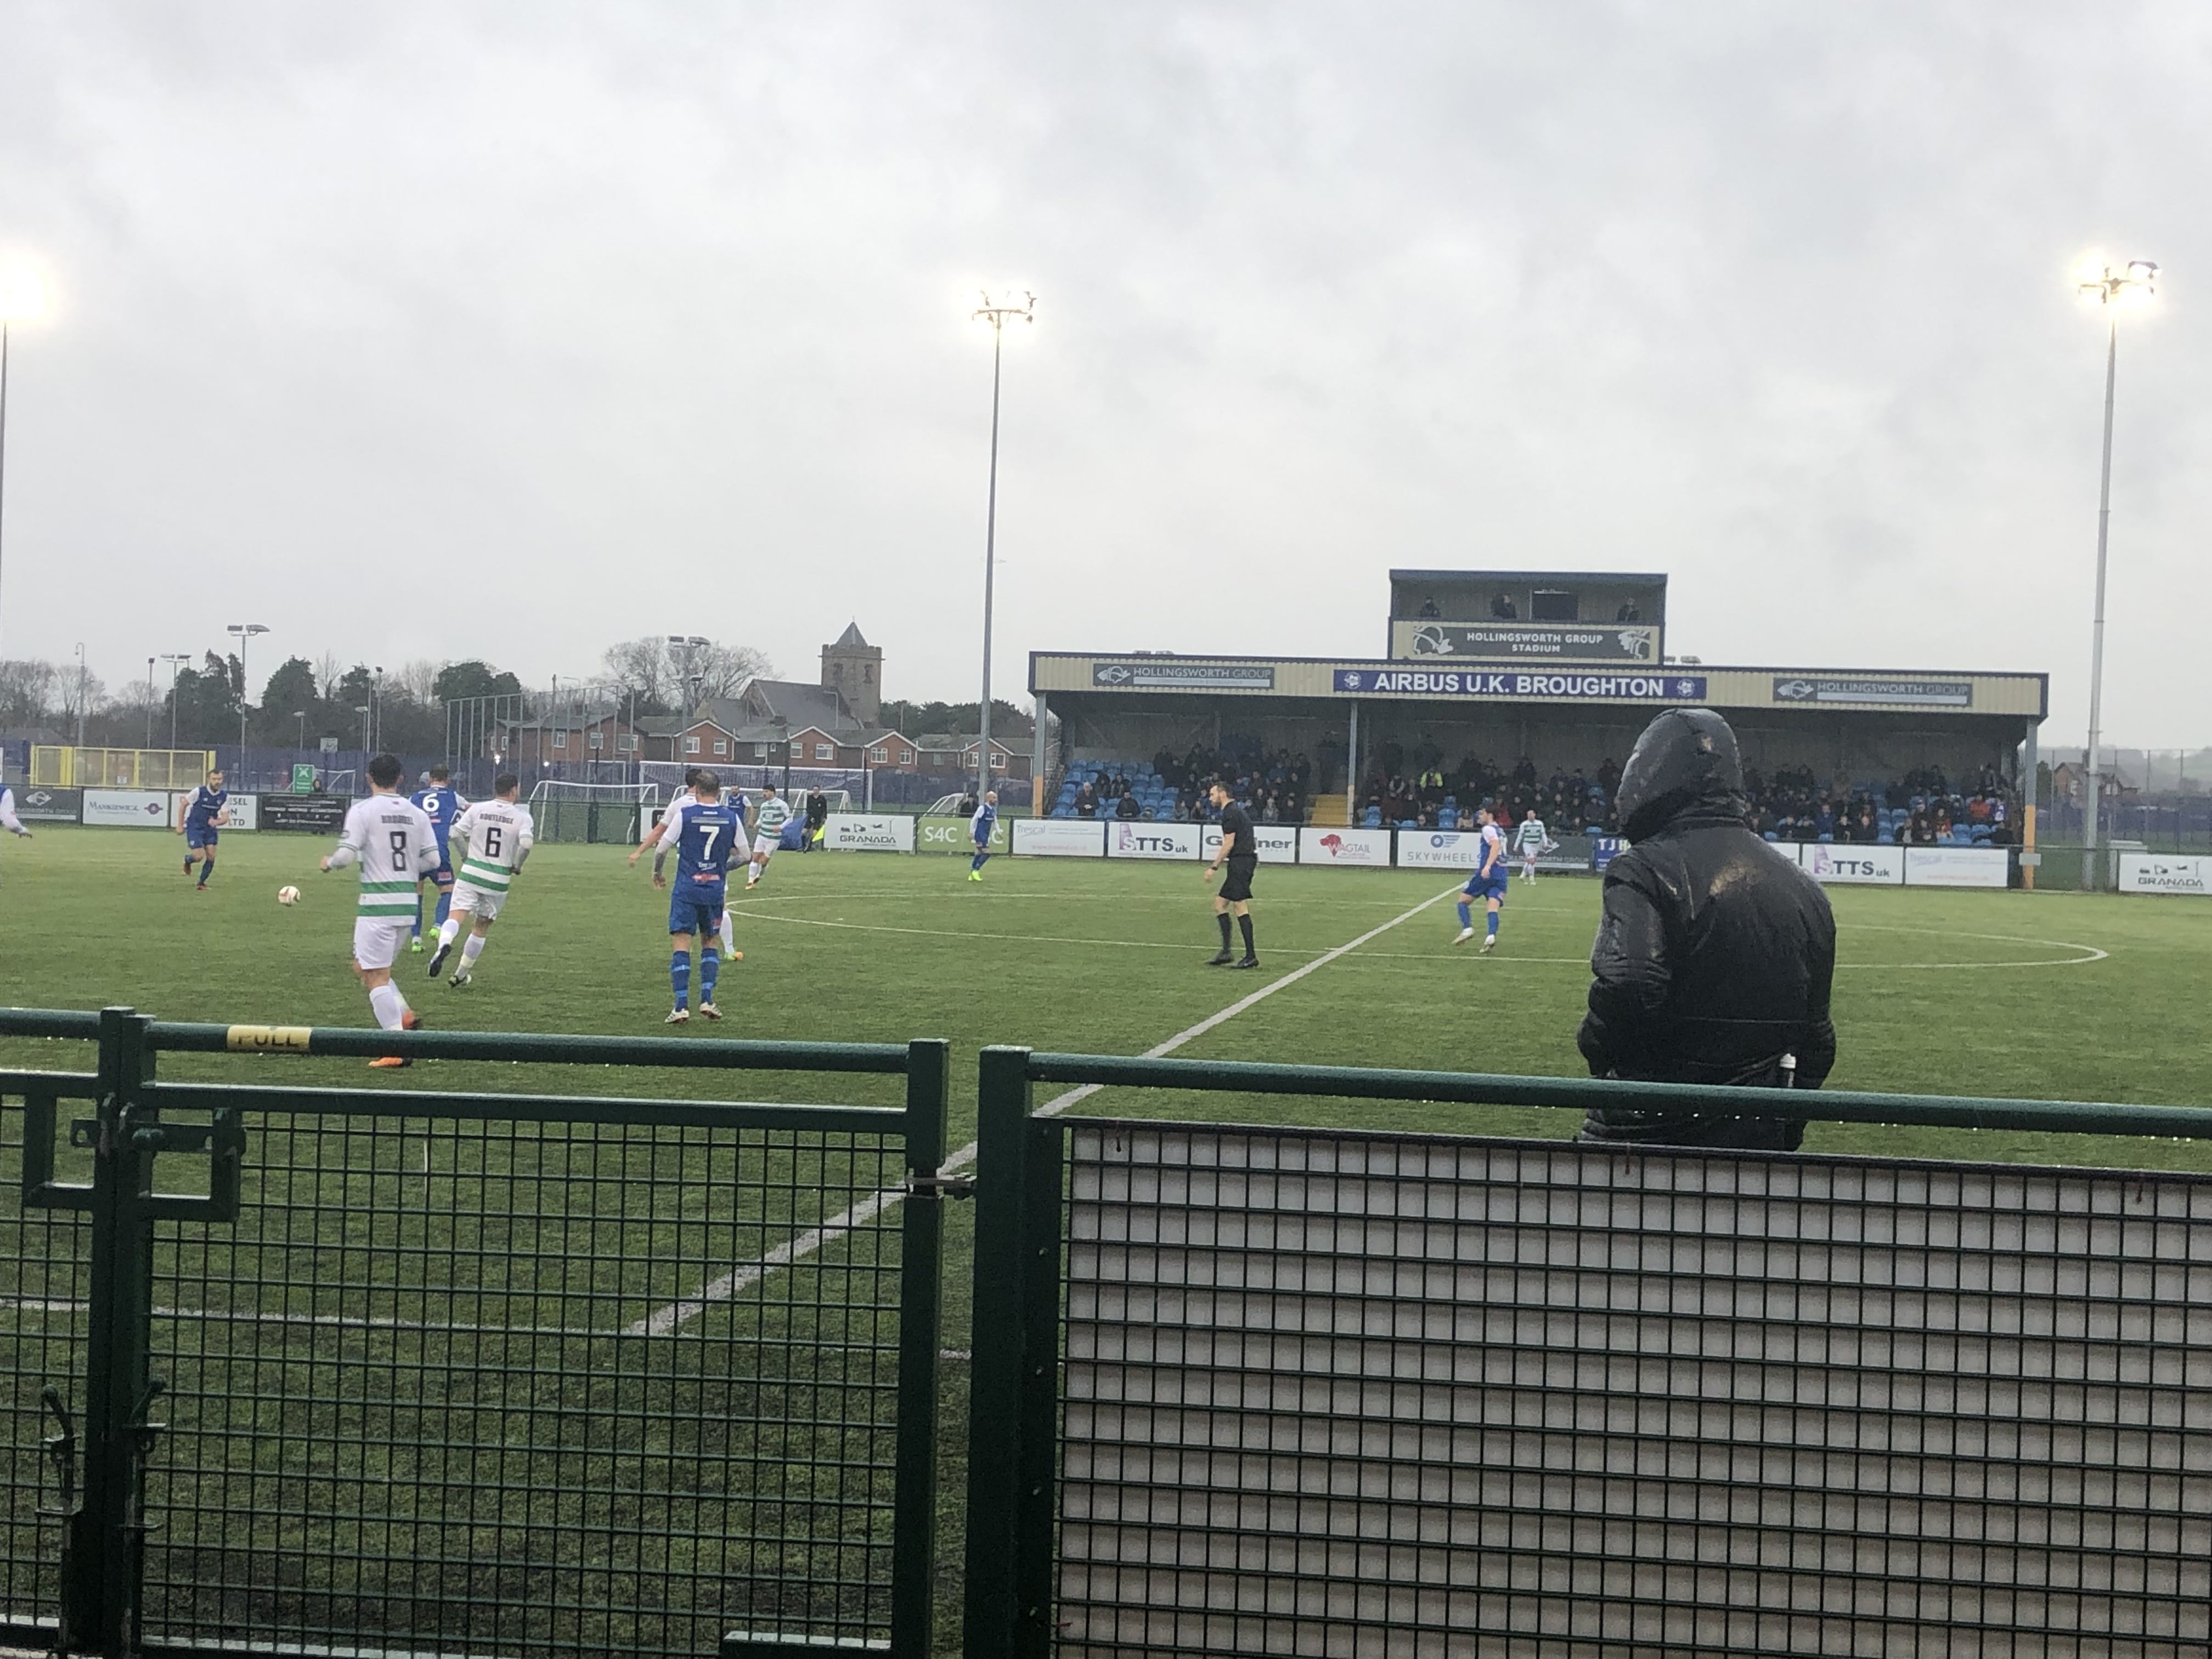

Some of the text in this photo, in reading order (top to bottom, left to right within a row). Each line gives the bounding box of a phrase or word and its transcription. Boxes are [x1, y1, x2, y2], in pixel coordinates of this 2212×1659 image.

[1467, 633, 1603, 644] HOLLINGSWORTH GROUP
[1512, 644, 1560, 653] STADIUM
[1133, 667, 1272, 679] HOLLINGSWORTH GROUP
[1374, 673, 1664, 696] AIRBUS U.K. BROUGHTON
[1817, 681, 1967, 695] HOLLINGSWORTH GROUP
[422, 793, 439, 812] 6
[479, 813, 514, 825] ROUTLEDGE
[924, 826, 957, 843] S4C
[1017, 825, 1046, 834] Trescal
[485, 827, 502, 858] 6
[699, 825, 720, 860] 7
[839, 835, 896, 843] GRANADA
[390, 831, 407, 872] 8
[1328, 843, 1371, 853] WAGTAIL
[2138, 877, 2204, 887] GRANADA
